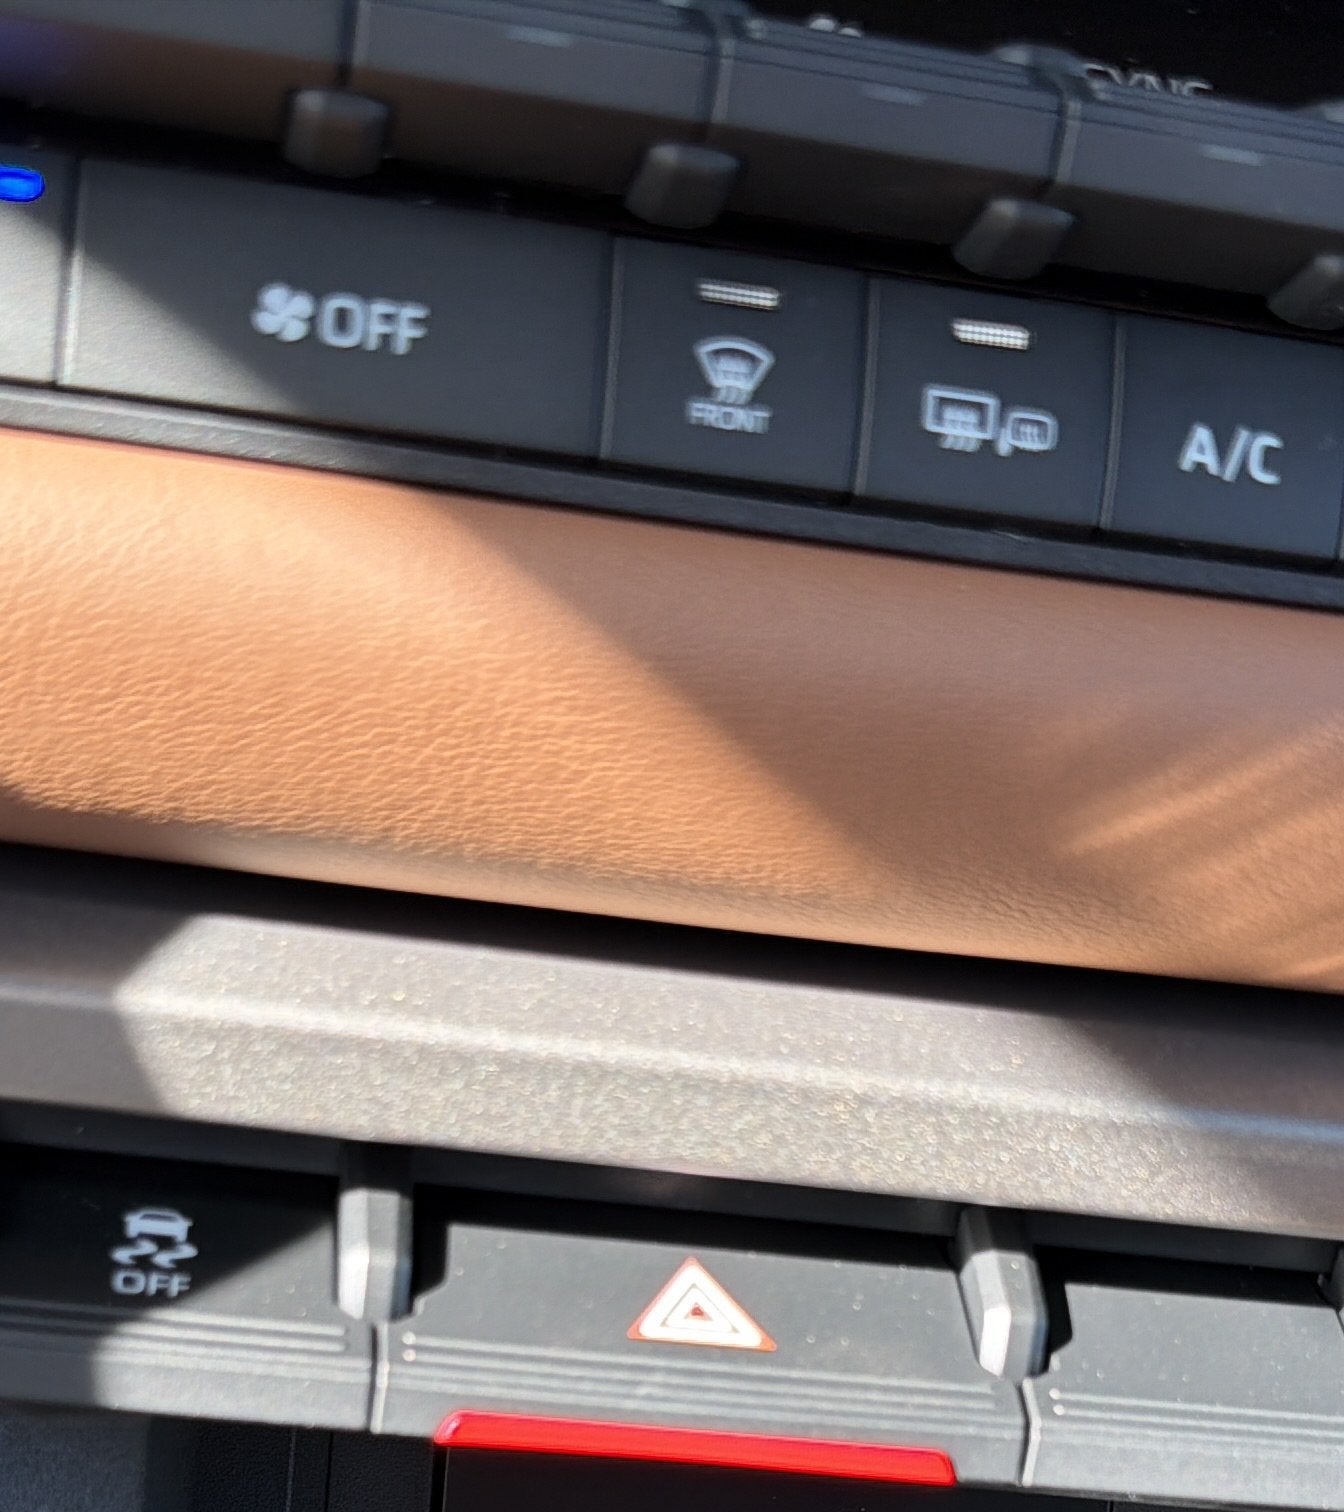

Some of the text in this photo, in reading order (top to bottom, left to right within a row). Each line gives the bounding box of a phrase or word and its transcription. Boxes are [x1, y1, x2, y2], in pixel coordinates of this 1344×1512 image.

[316, 291, 430, 356] OFF
[686, 401, 772, 434] FRONT
[1178, 424, 1284, 486] A/C
[111, 1270, 192, 1297] OFF
